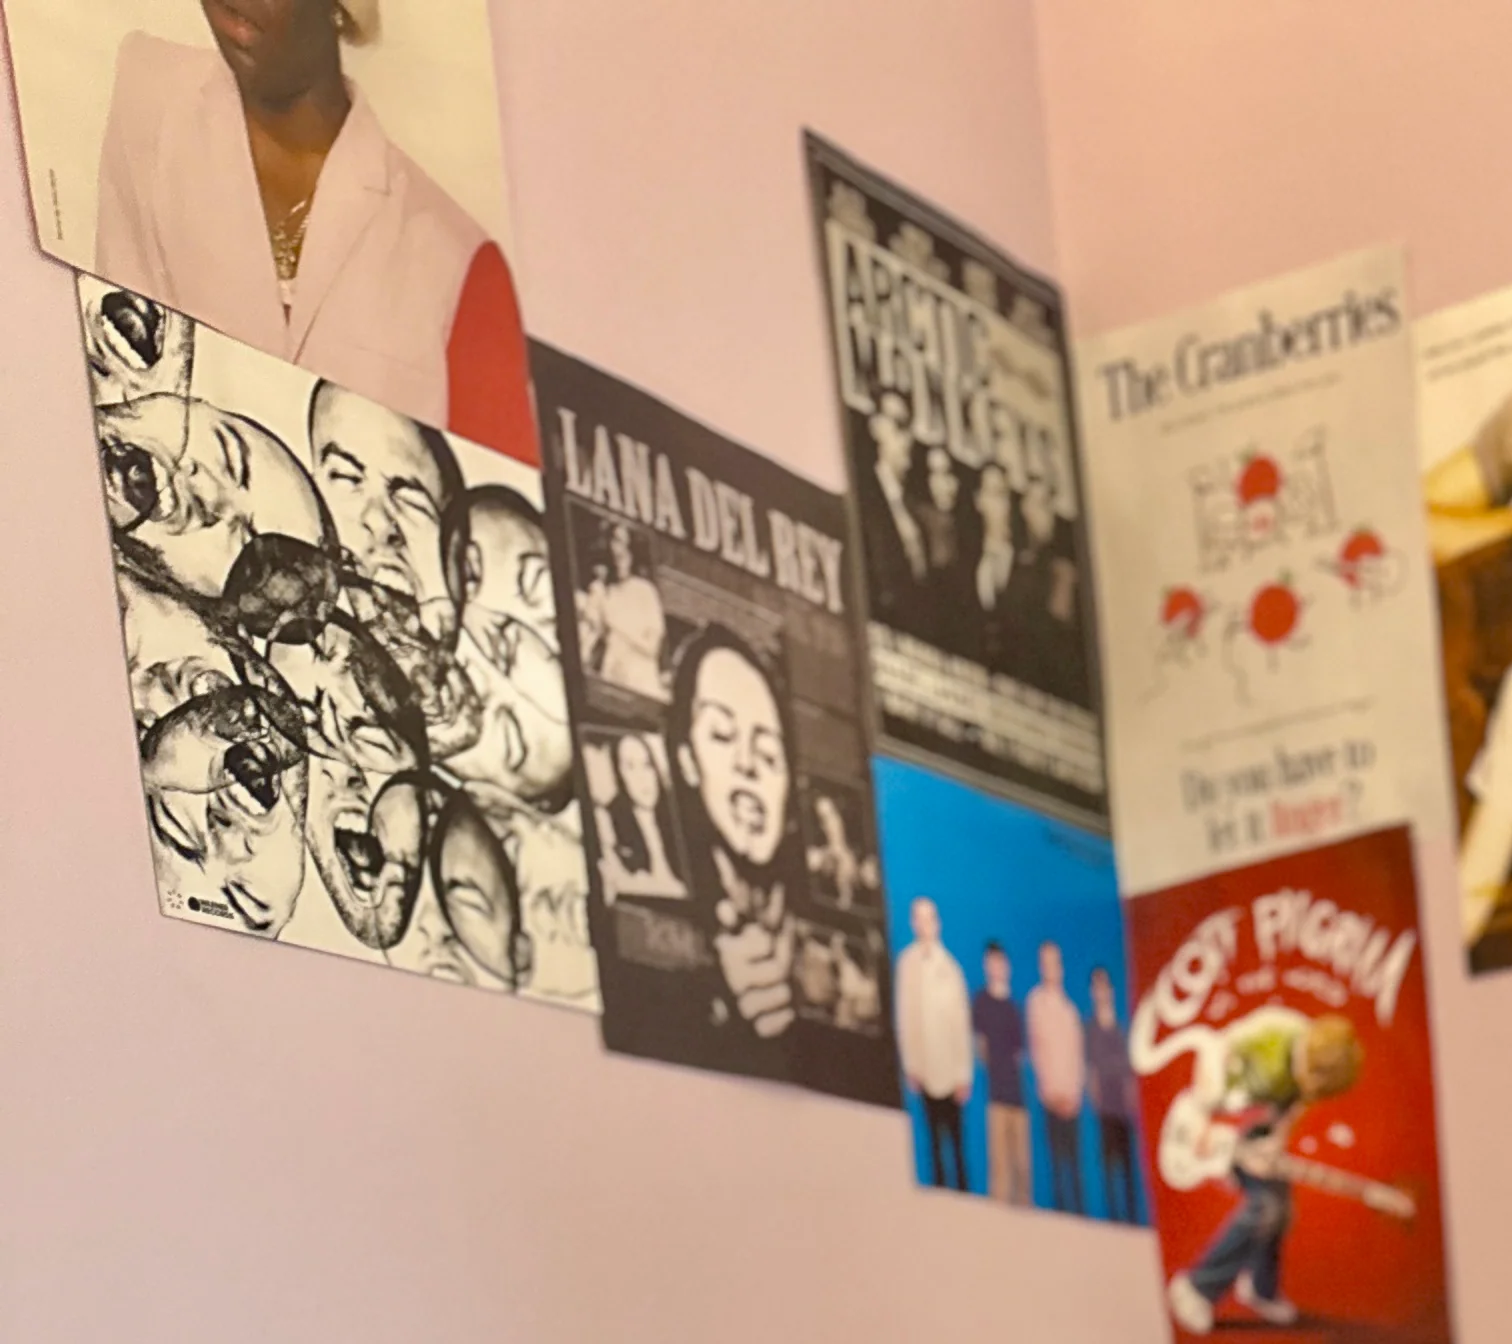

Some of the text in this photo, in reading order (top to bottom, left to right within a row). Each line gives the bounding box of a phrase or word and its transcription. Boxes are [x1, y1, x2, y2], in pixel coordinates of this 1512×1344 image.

[1097, 355, 1167, 422] The
[1173, 285, 1400, 396] Cranberries
[557, 405, 844, 615] LANA DEL REY
